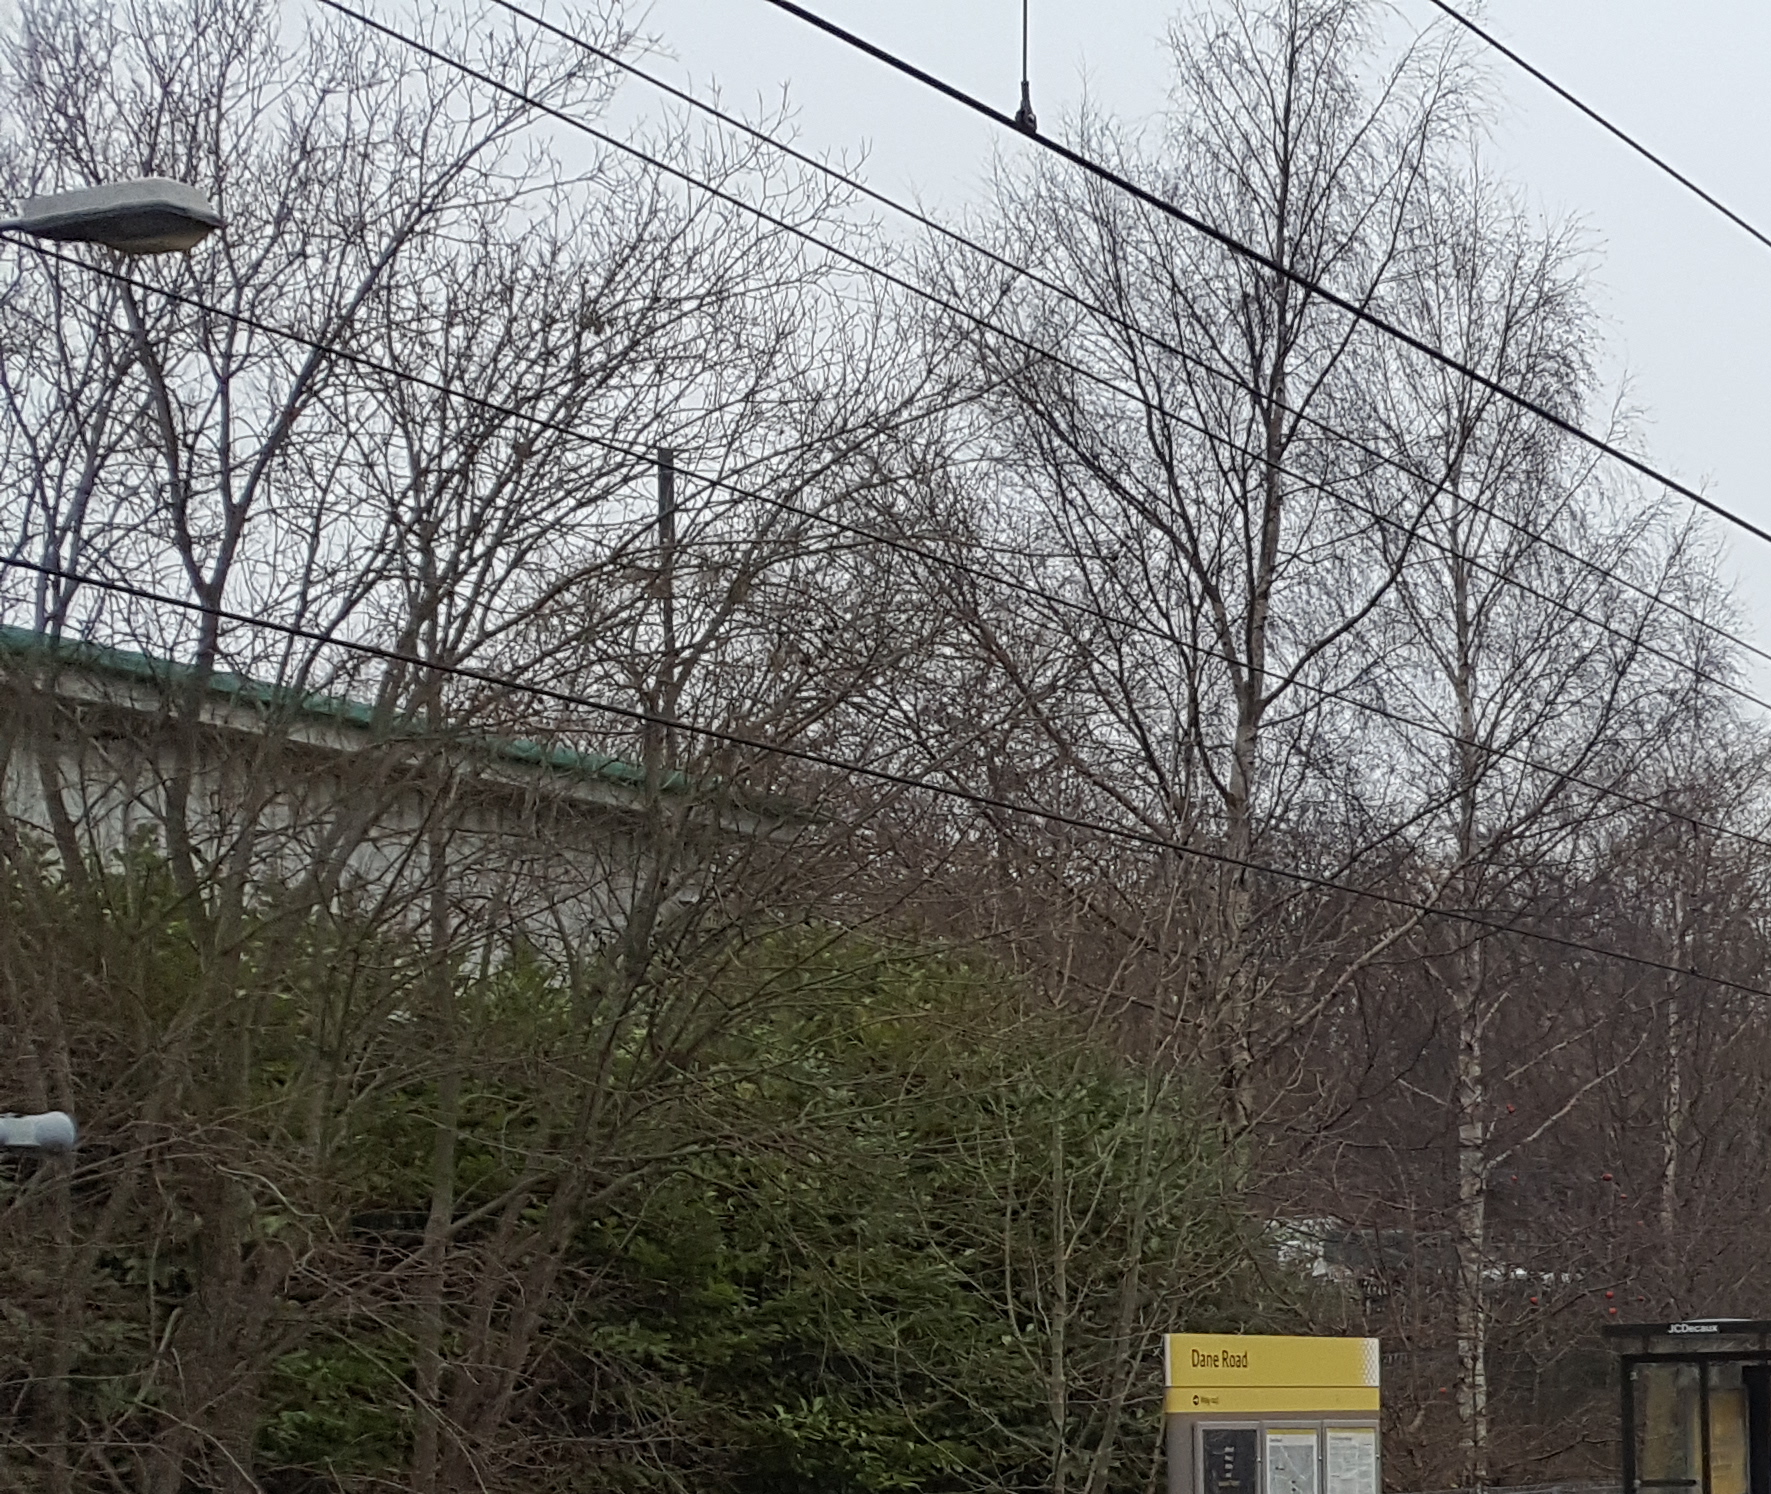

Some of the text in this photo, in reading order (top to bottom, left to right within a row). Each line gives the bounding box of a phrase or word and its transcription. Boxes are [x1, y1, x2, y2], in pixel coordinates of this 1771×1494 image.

[1667, 1323, 1718, 1334] JCDecaux
[1191, 1348, 1248, 1368] Dane Road
